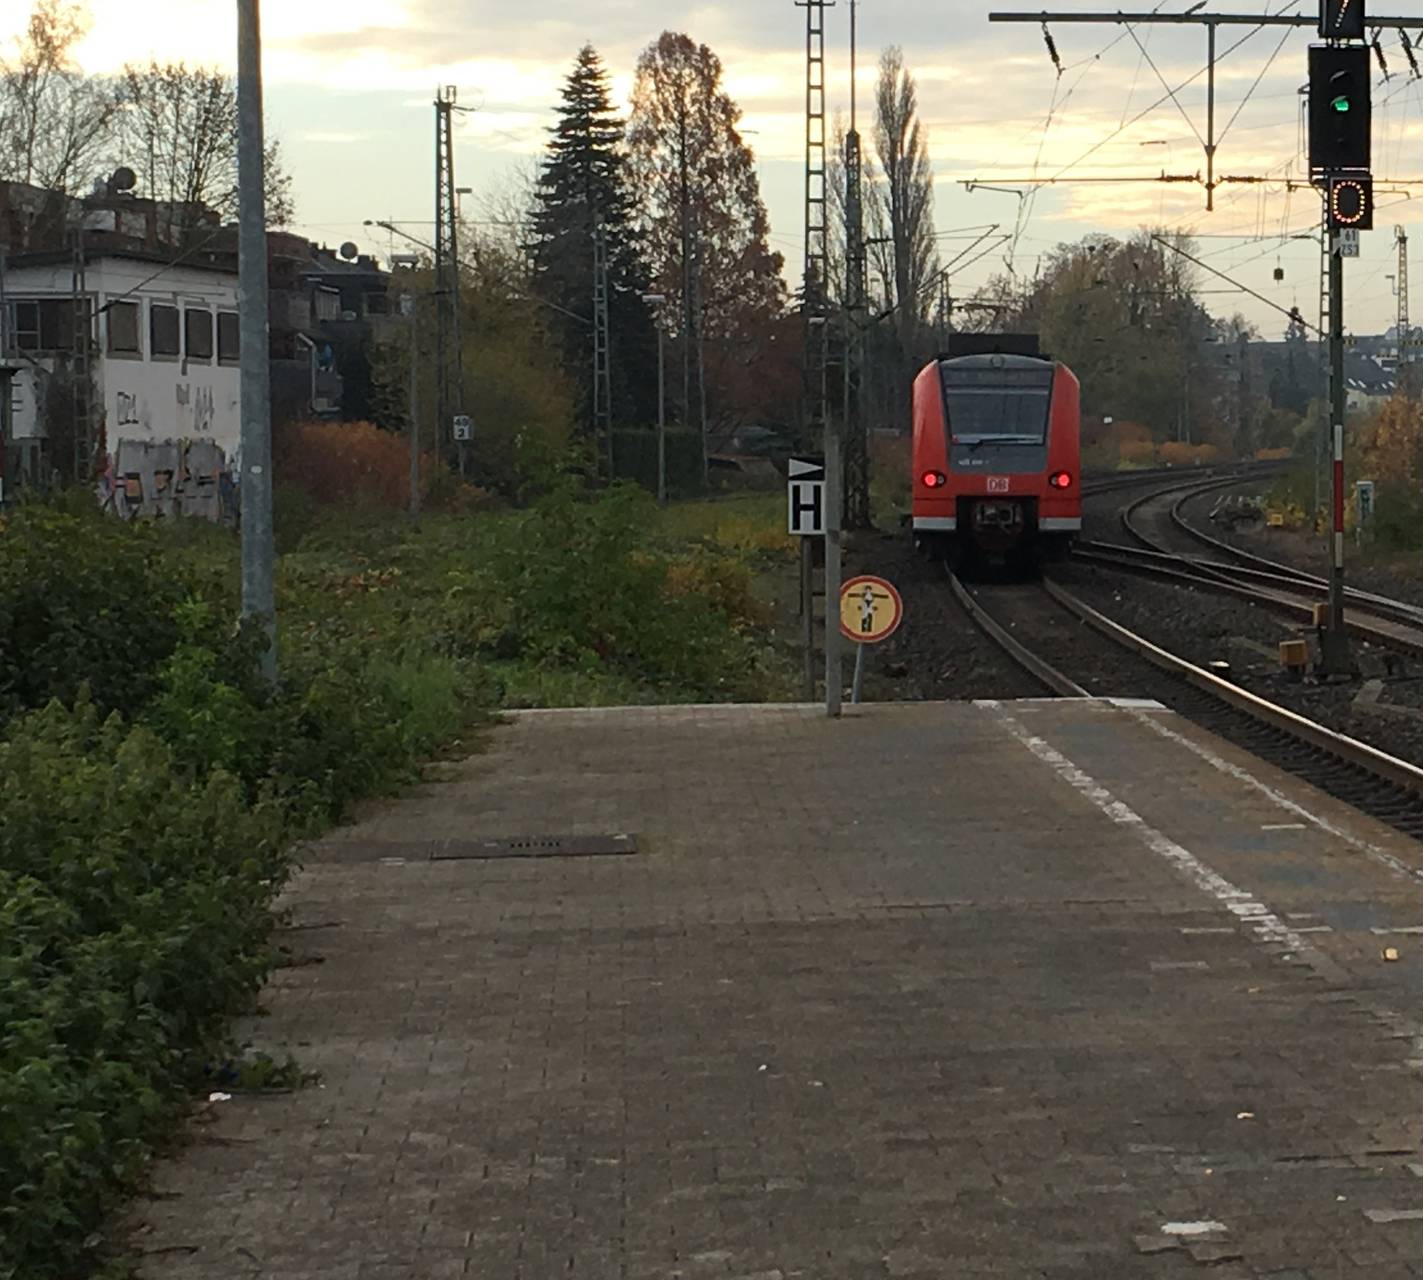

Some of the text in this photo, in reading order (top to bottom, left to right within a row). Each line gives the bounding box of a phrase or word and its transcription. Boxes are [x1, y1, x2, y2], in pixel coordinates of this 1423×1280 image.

[1345, 230, 1356, 242] 61
[988, 478, 1007, 491] DB
[793, 485, 821, 530] H
